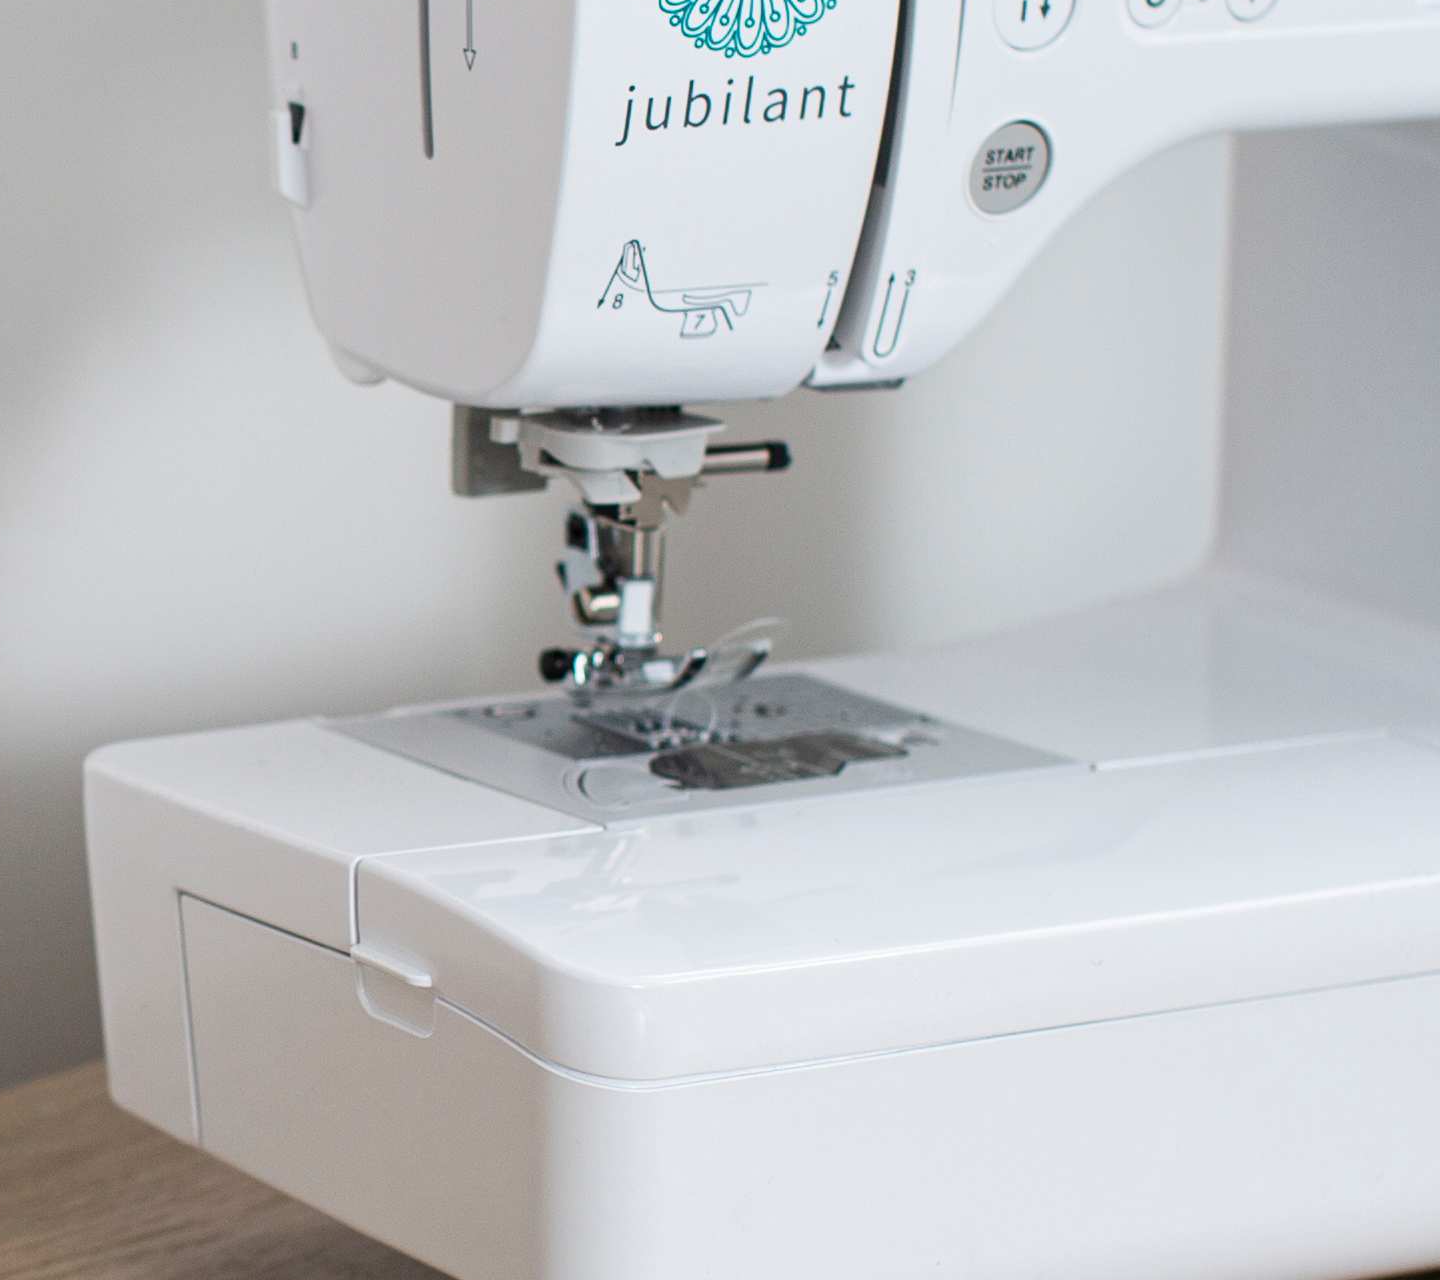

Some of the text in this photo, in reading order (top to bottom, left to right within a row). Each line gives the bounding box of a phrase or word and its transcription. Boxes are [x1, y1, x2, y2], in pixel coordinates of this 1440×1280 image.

[615, 75, 856, 147] jubilant
[985, 146, 1035, 166] START
[982, 173, 1027, 192] STOP
[904, 269, 917, 287] 3
[612, 293, 624, 310] 8
[694, 314, 706, 330] 7
